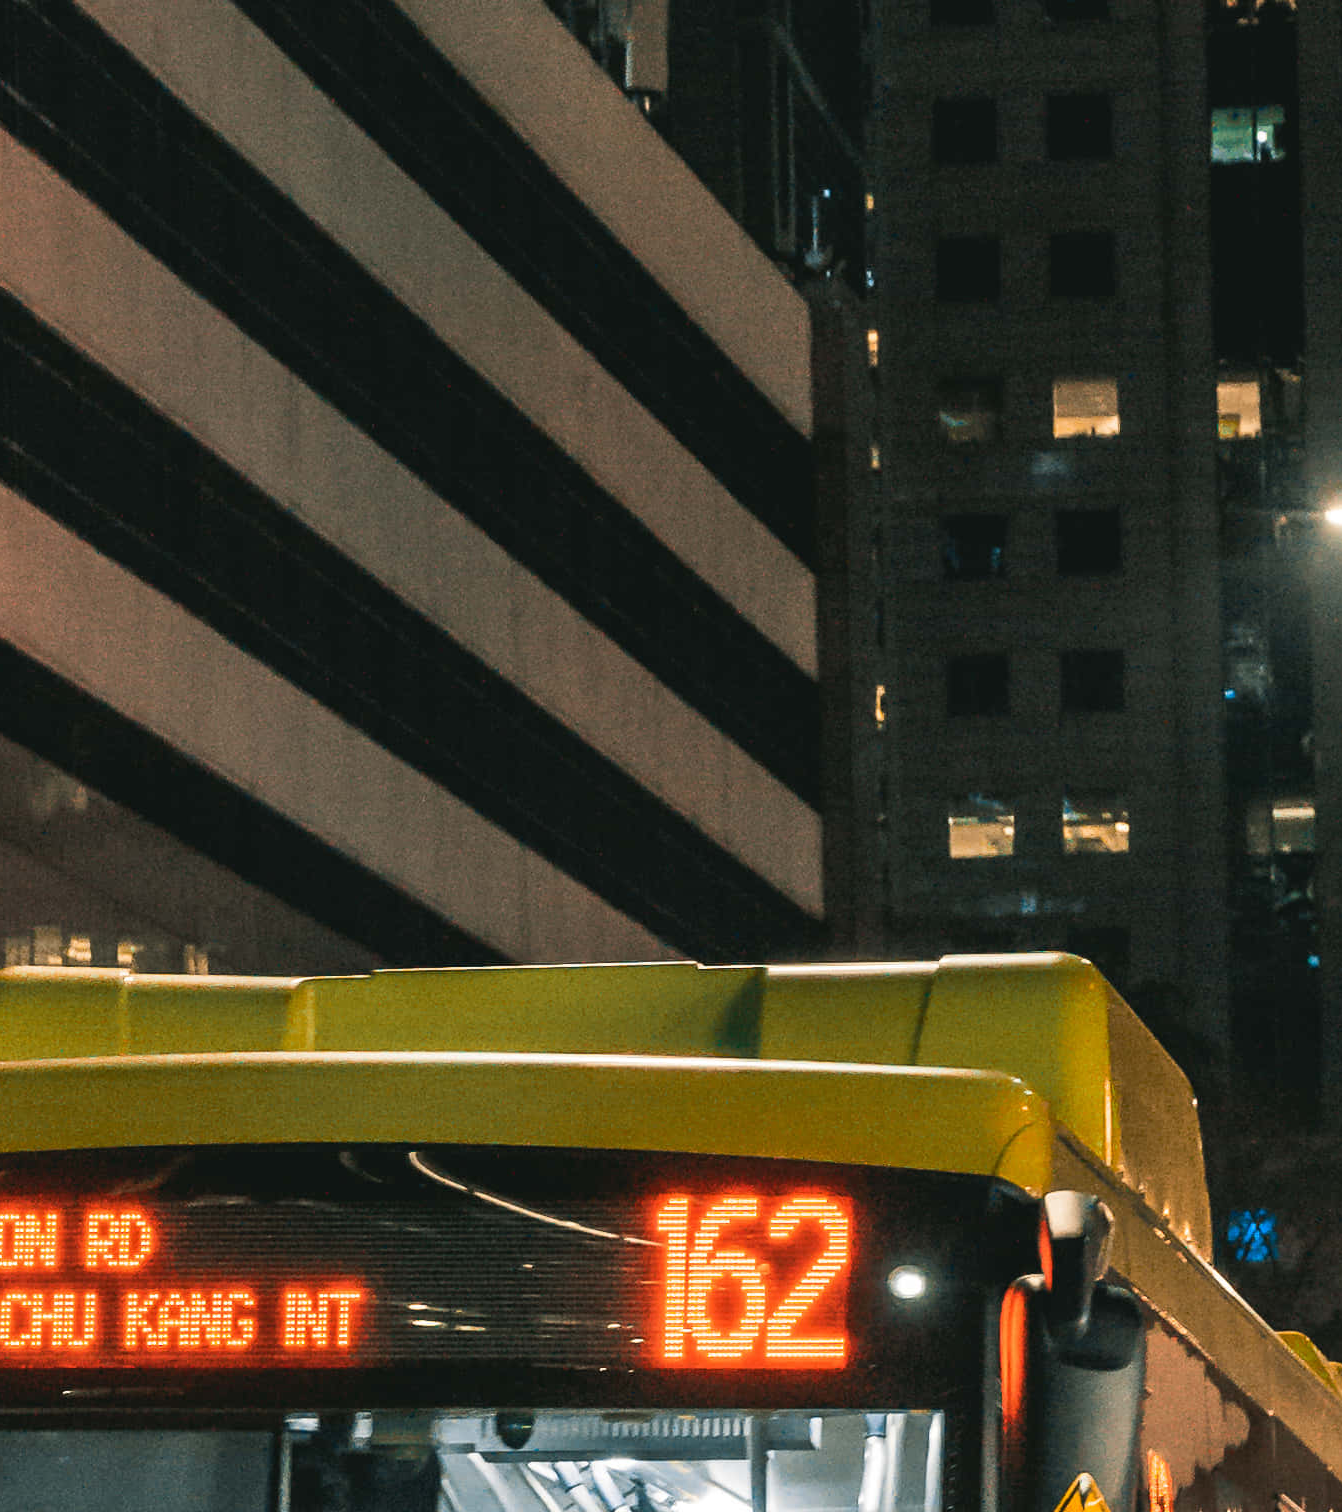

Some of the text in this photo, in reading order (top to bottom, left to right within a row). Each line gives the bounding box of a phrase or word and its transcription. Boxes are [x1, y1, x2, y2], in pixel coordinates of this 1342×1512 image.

[85, 1212, 152, 1268] RD
[657, 1197, 849, 1359] 162
[124, 1292, 255, 1347] KANG
[282, 1292, 363, 1347] INT
